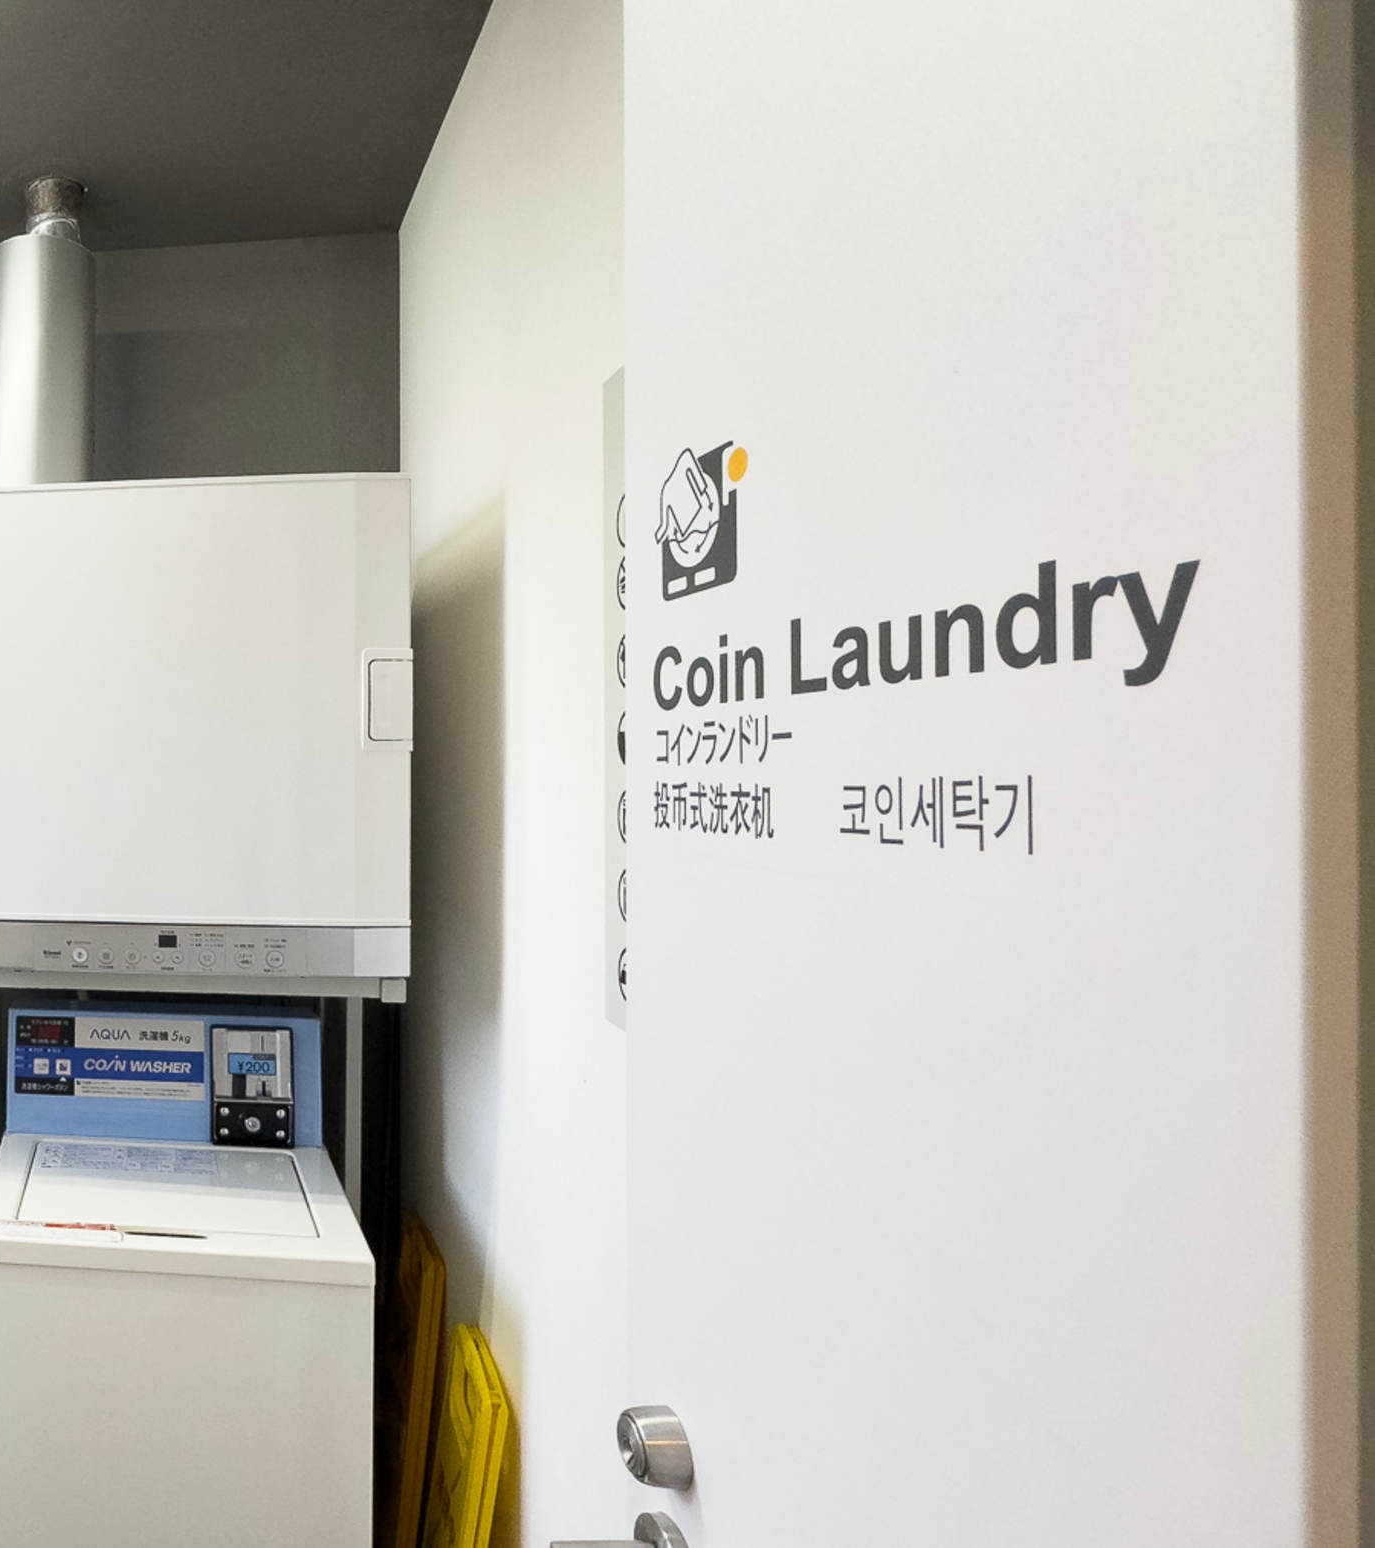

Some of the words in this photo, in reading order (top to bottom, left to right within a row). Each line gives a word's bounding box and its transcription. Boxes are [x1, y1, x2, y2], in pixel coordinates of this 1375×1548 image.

[653, 633, 765, 711] Coin
[790, 558, 1201, 695] Laundry
[654, 713, 793, 766] コインランドリー
[653, 780, 775, 840] 投币式洗衣机
[839, 773, 1035, 856] 코인세탁기
[90, 1028, 131, 1041] AQUA
[170, 1030, 192, 1045] 5kg
[130, 1059, 192, 1075] WASHER
[237, 1061, 270, 1073] ¥200
